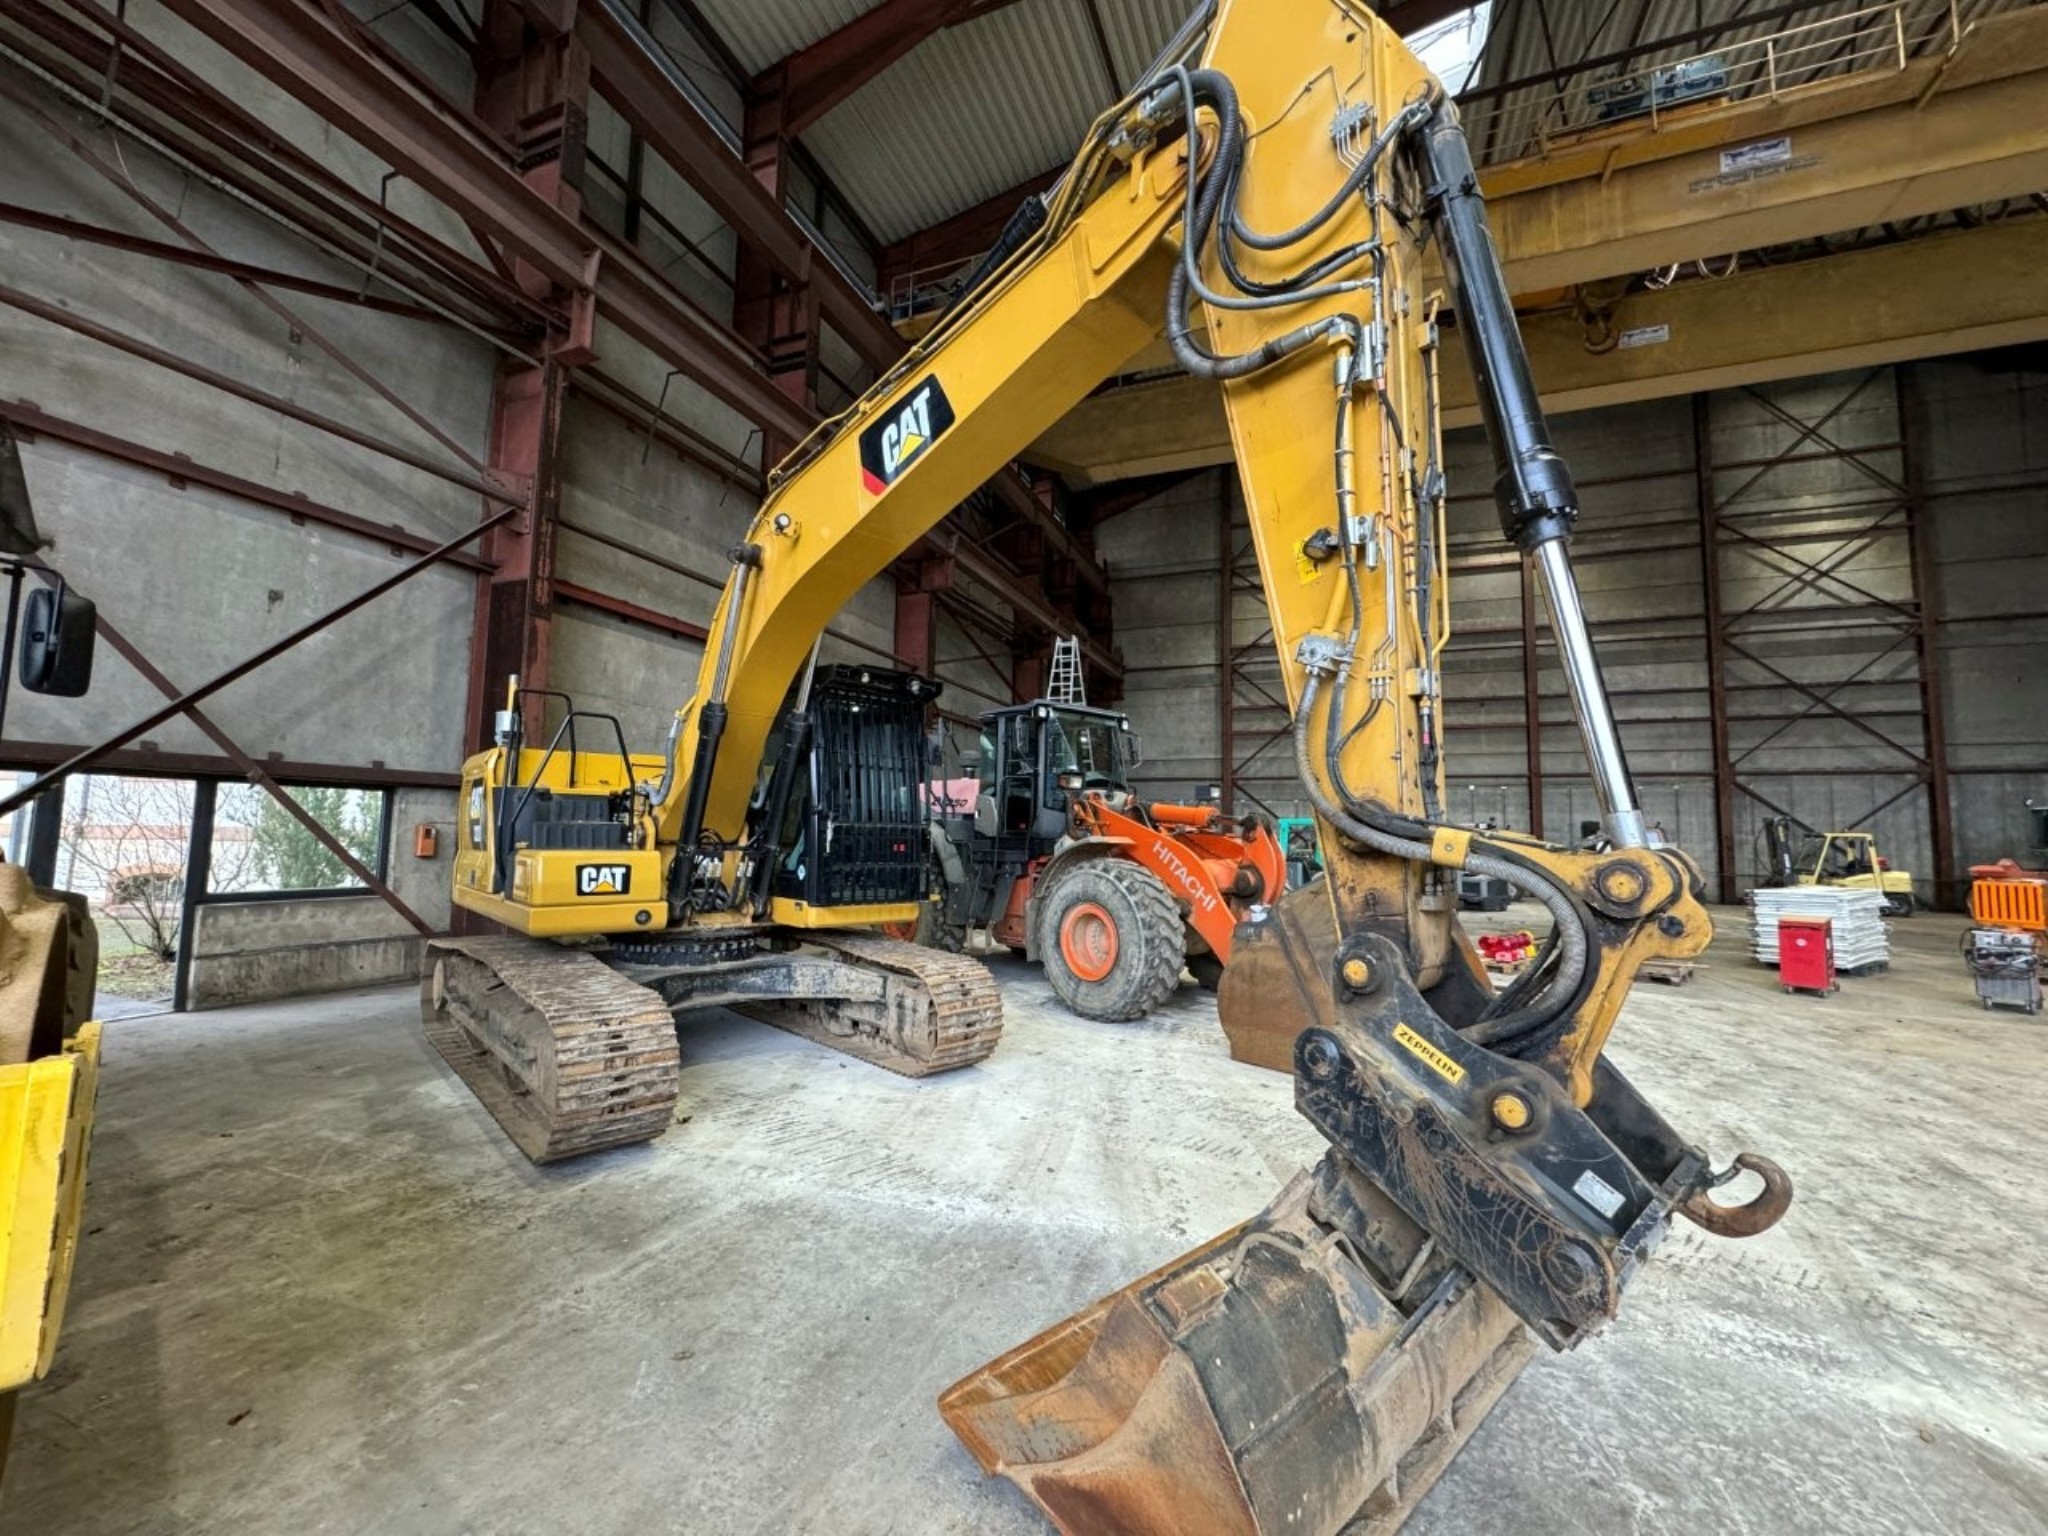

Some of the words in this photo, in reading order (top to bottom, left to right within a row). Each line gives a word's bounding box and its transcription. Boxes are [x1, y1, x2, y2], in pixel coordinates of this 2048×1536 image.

[881, 386, 931, 474] CAT
[581, 867, 626, 893] CAT
[1152, 839, 1217, 912] HITACHI
[1399, 1030, 1458, 1077] ZEPPELIN
